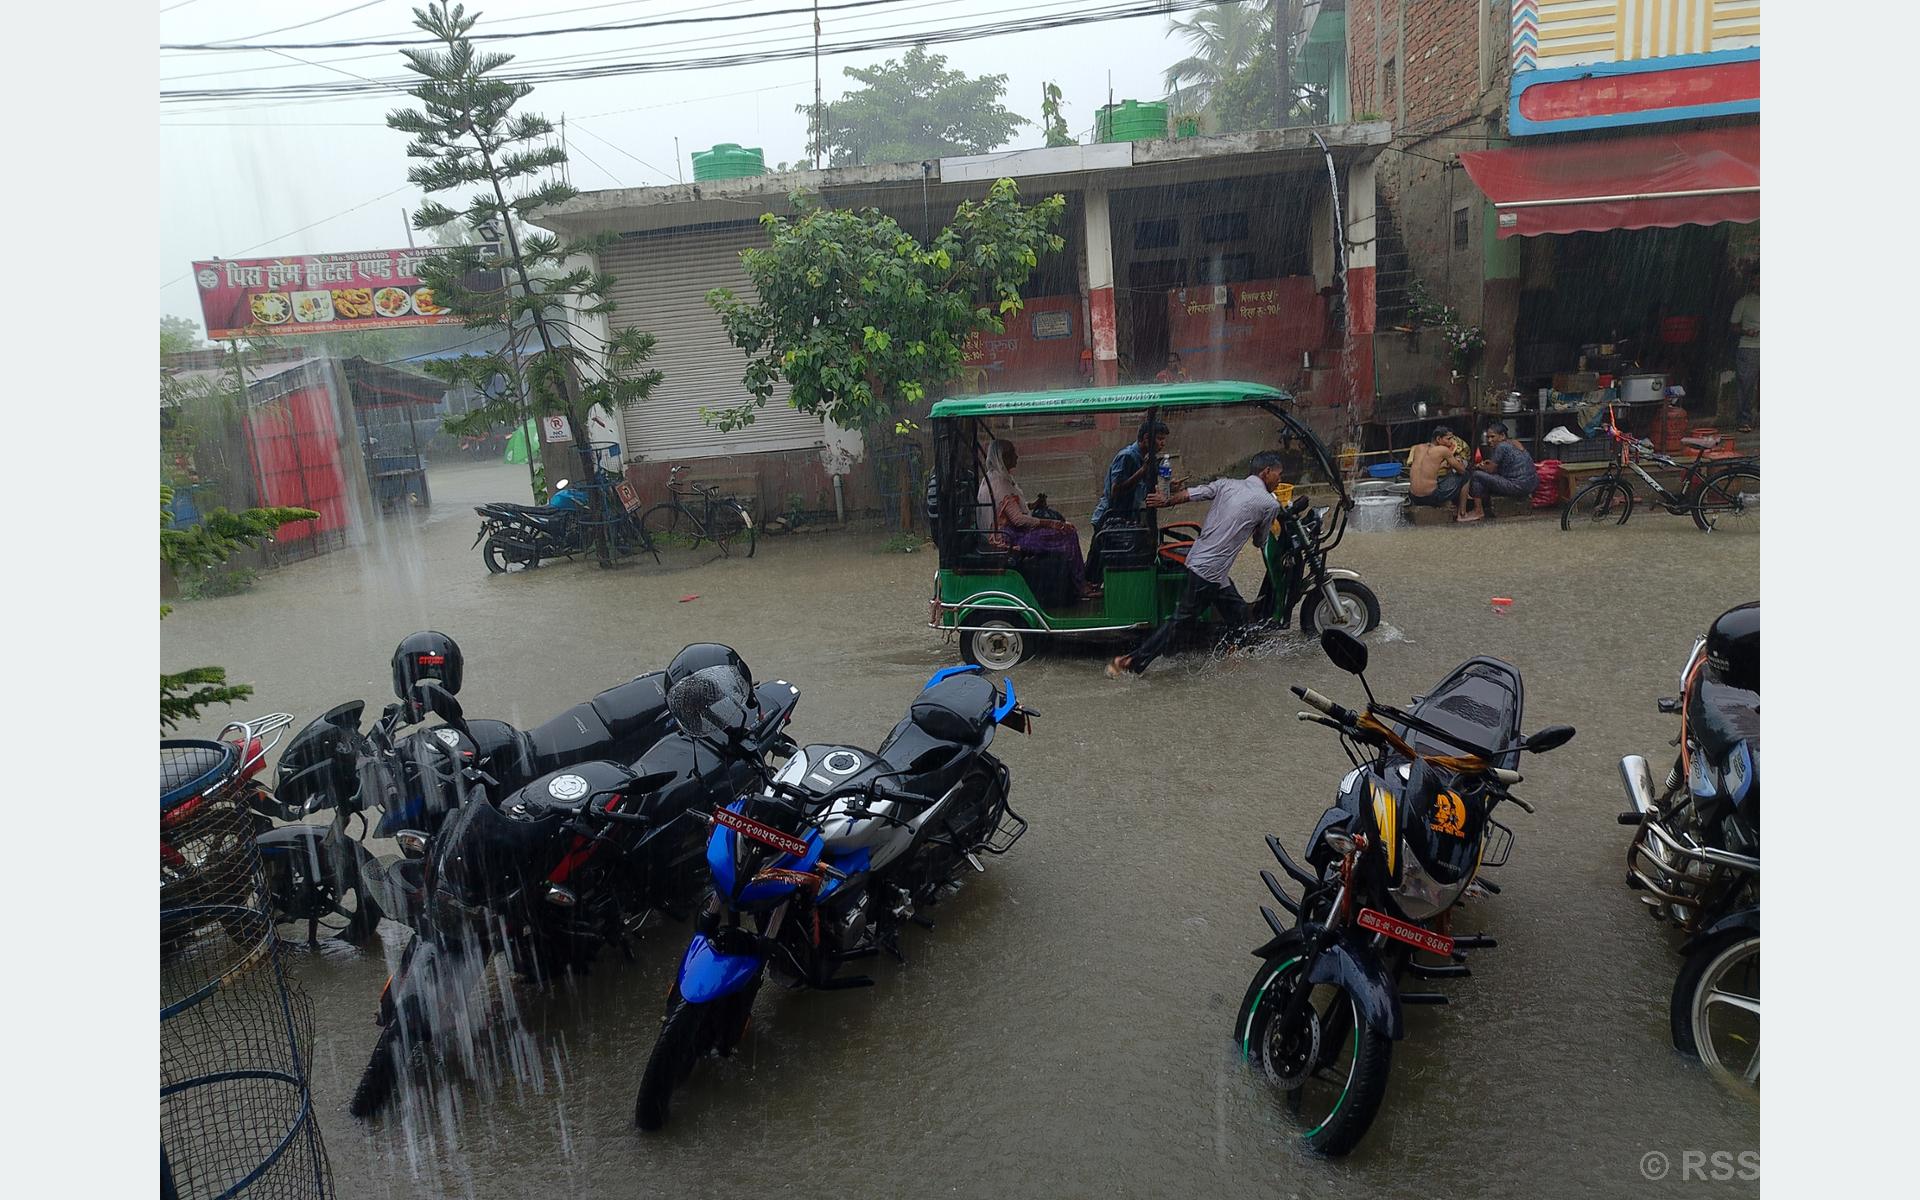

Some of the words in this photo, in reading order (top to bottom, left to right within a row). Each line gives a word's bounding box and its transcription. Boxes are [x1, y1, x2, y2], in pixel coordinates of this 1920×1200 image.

[225, 262, 263, 289] पिस
[267, 260, 303, 291] होम
[305, 257, 354, 289] होटल
[358, 258, 394, 281] एण्ड
